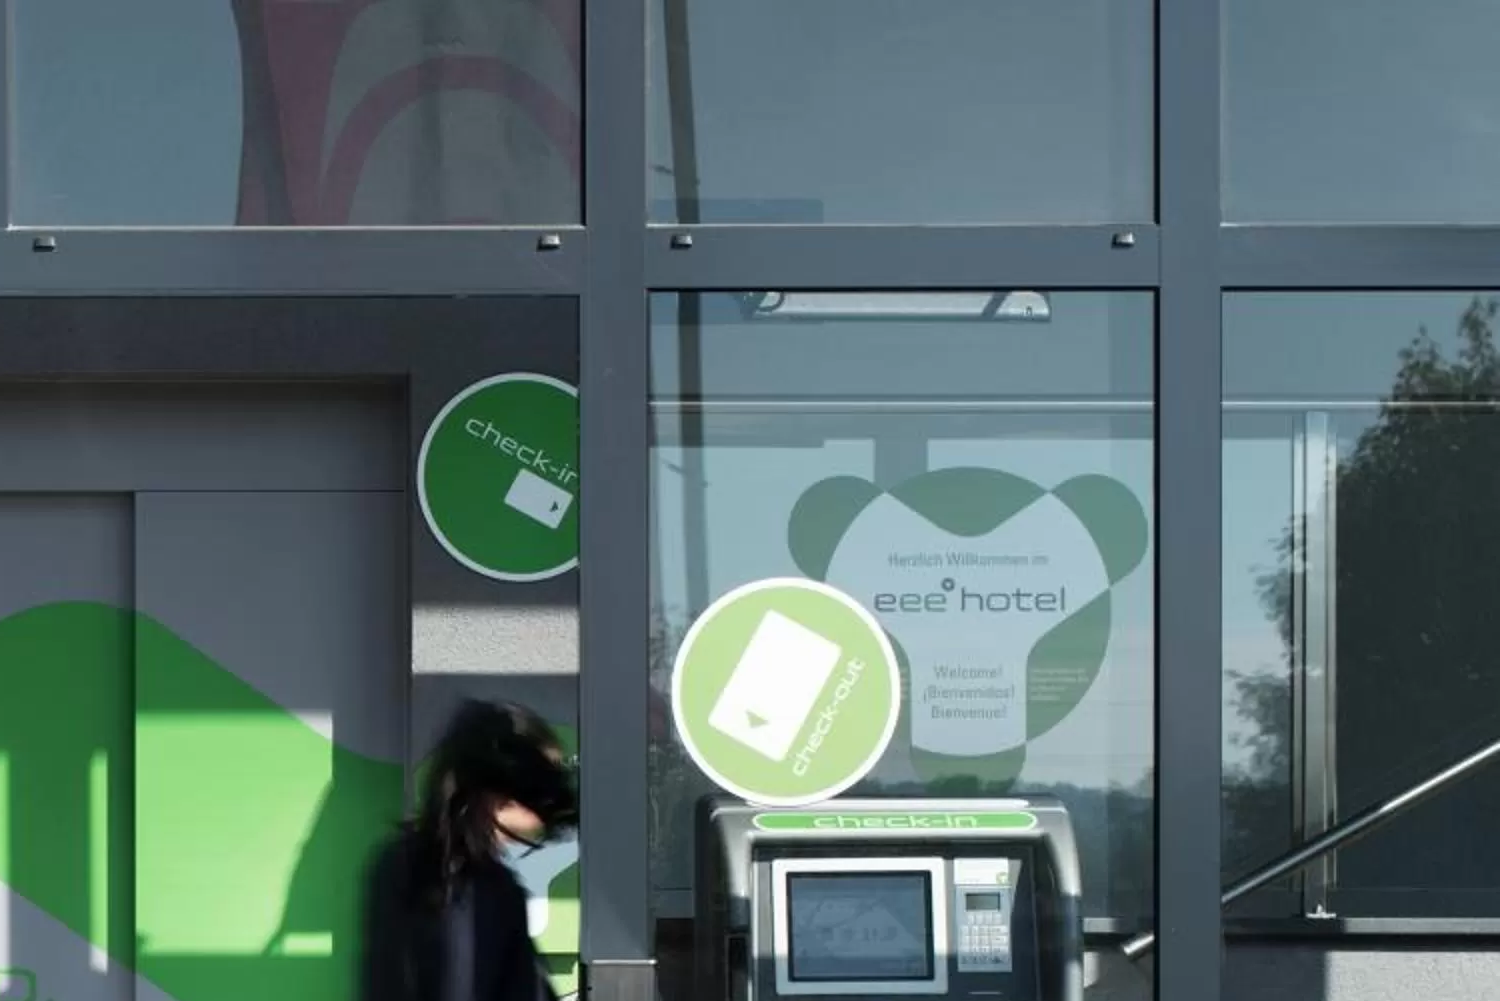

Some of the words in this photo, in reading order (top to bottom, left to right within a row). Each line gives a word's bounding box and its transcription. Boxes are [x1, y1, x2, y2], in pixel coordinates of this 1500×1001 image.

[961, 585, 1066, 612] hotel
[933, 664, 1002, 679] Welcome!
[792, 657, 866, 776] check-out
[813, 814, 977, 828] check-in
